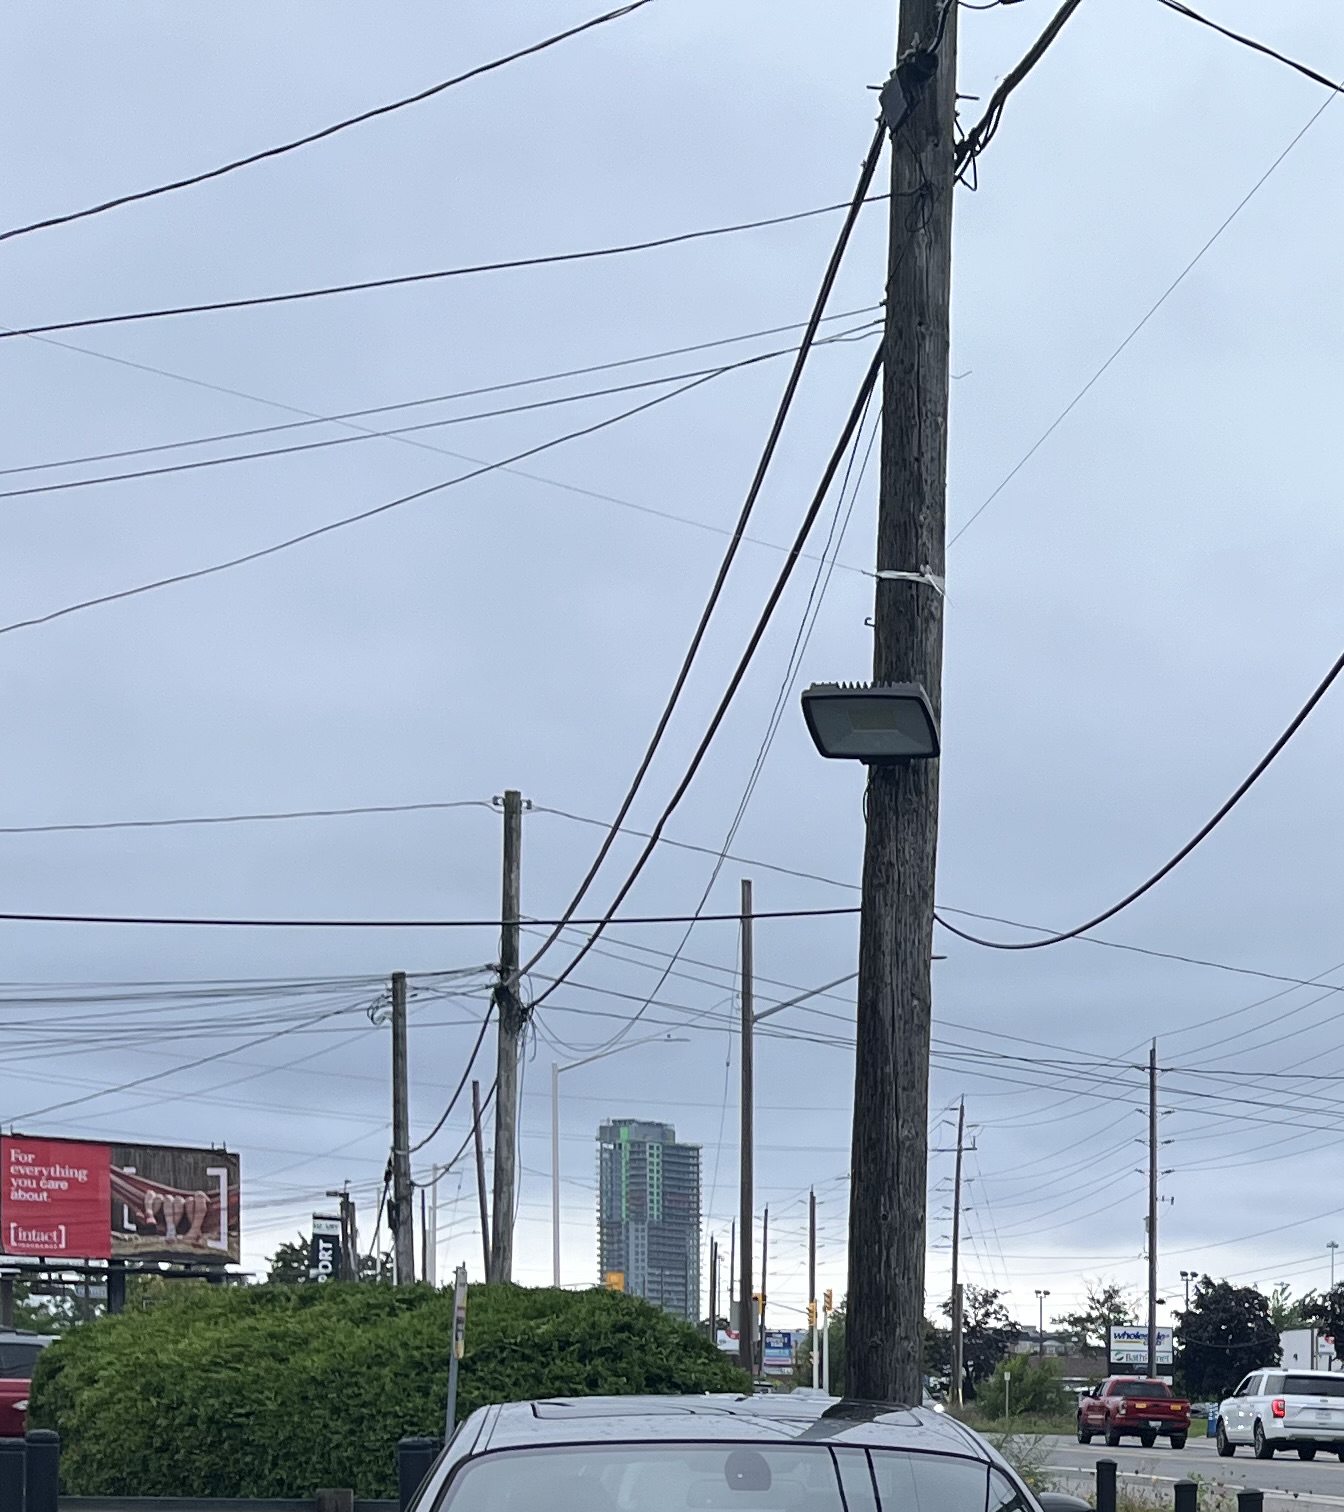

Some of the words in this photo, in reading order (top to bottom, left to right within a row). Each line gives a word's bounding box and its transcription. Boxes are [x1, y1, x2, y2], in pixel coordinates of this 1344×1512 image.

[10, 1148, 36, 1163] For
[10, 1164, 88, 1182] everything
[10, 1177, 37, 1189] you
[40, 1180, 69, 1190] care
